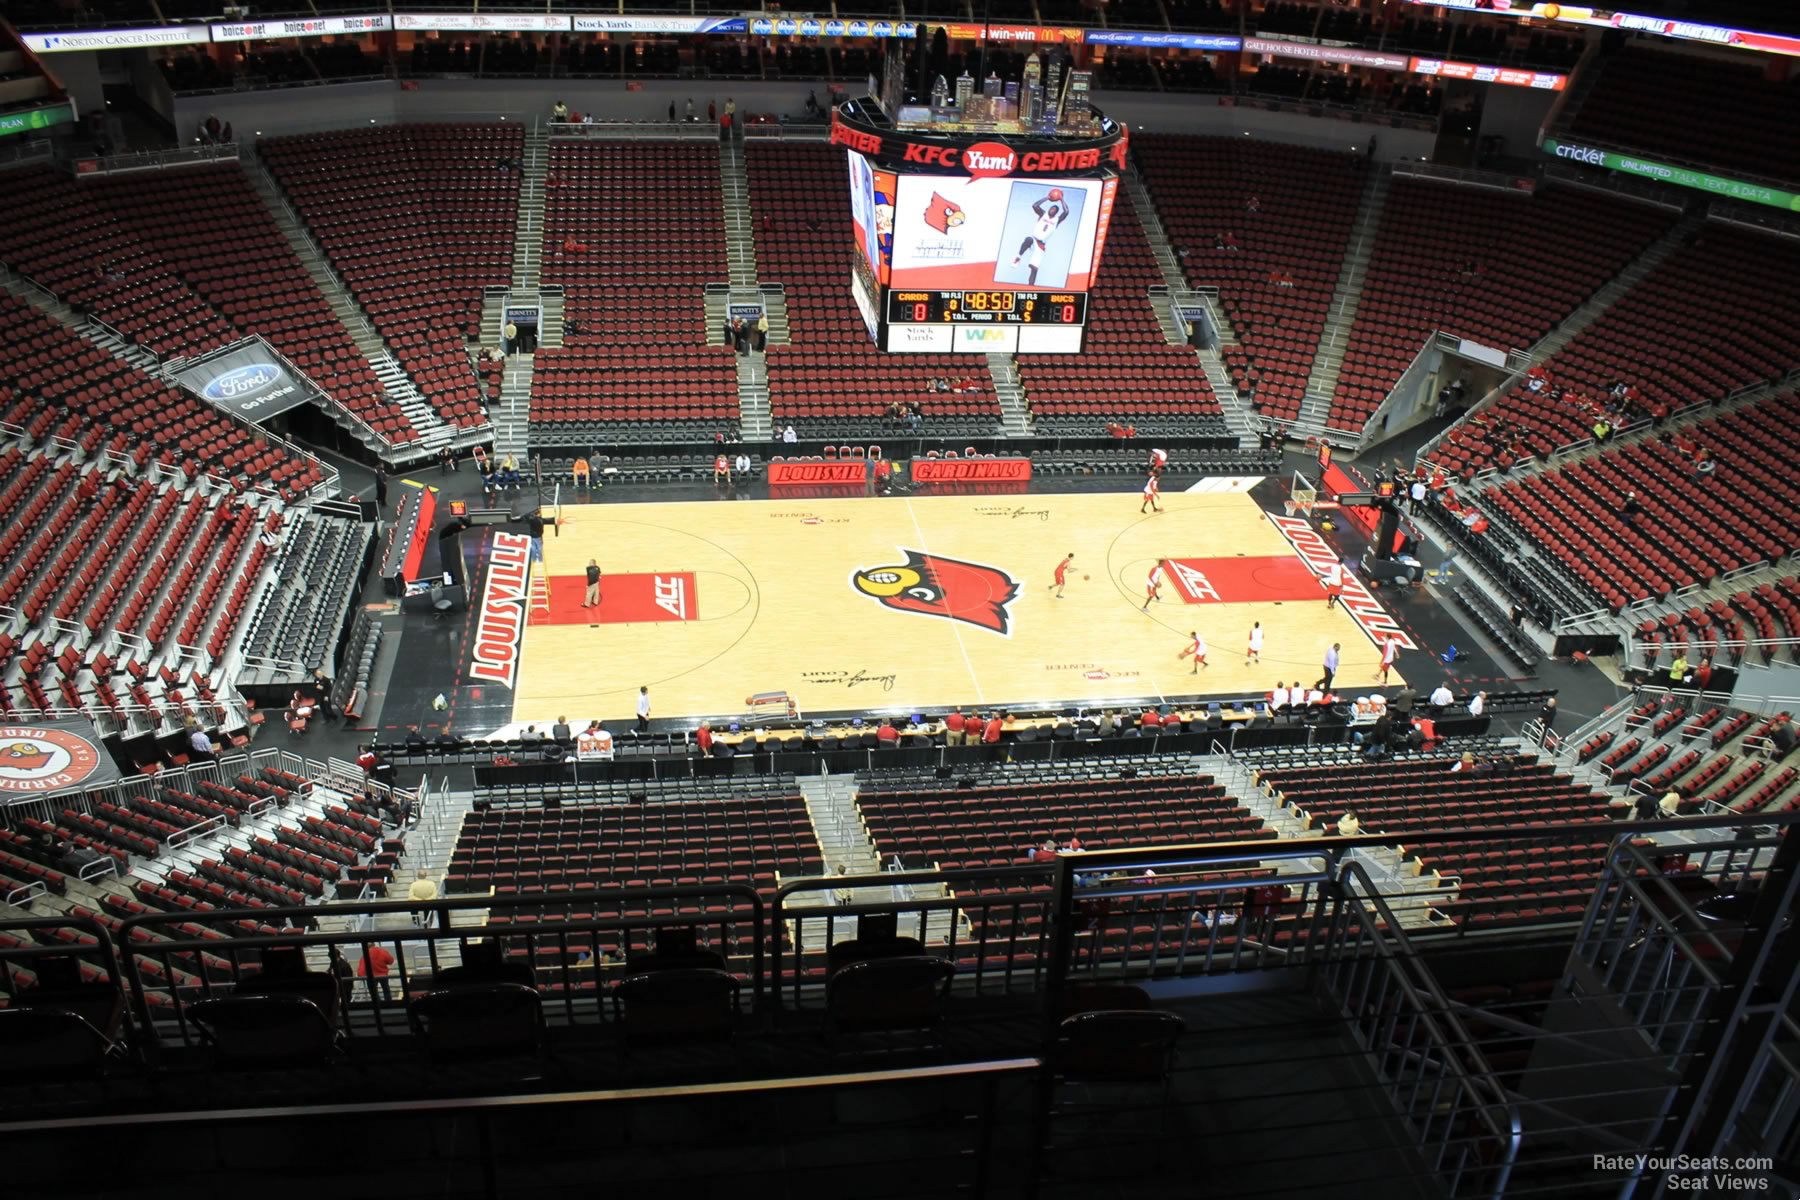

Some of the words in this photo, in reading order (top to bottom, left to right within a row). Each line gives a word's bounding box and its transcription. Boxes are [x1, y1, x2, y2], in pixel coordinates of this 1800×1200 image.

[577, 20, 604, 28] Stock
[606, 20, 632, 29] Yards
[634, 20, 660, 29] Bank
[661, 22, 669, 30] &
[670, 21, 696, 30] Trust
[62, 38, 102, 47] NORTON
[105, 35, 144, 45] CANCER
[145, 32, 192, 42] INSTITUTE
[990, 28, 1035, 40] win-win
[1245, 41, 1266, 50] GALT
[1266, 44, 1293, 53] HOUSE
[1294, 46, 1320, 57] HOTEL
[903, 142, 958, 168] KFC
[967, 150, 1014, 172] Yum!
[1021, 148, 1100, 172] CENTER
[1555, 144, 1606, 166] cricket
[1620, 160, 1672, 178] UNLIMITED
[1741, 187, 1771, 202] DATA
[898, 293, 928, 301] CARDS
[1050, 295, 1074, 303] BUCS
[914, 304, 927, 321] 0
[1062, 305, 1074, 322] 0
[220, 370, 269, 396] Ford
[240, 401, 259, 411] Go
[259, 385, 296, 404] Further
[916, 462, 1025, 479] CARDINALS
[1168, 560, 1222, 601] ACC
[655, 575, 685, 619] ACC
[470, 531, 532, 689] LOUISVILLE
